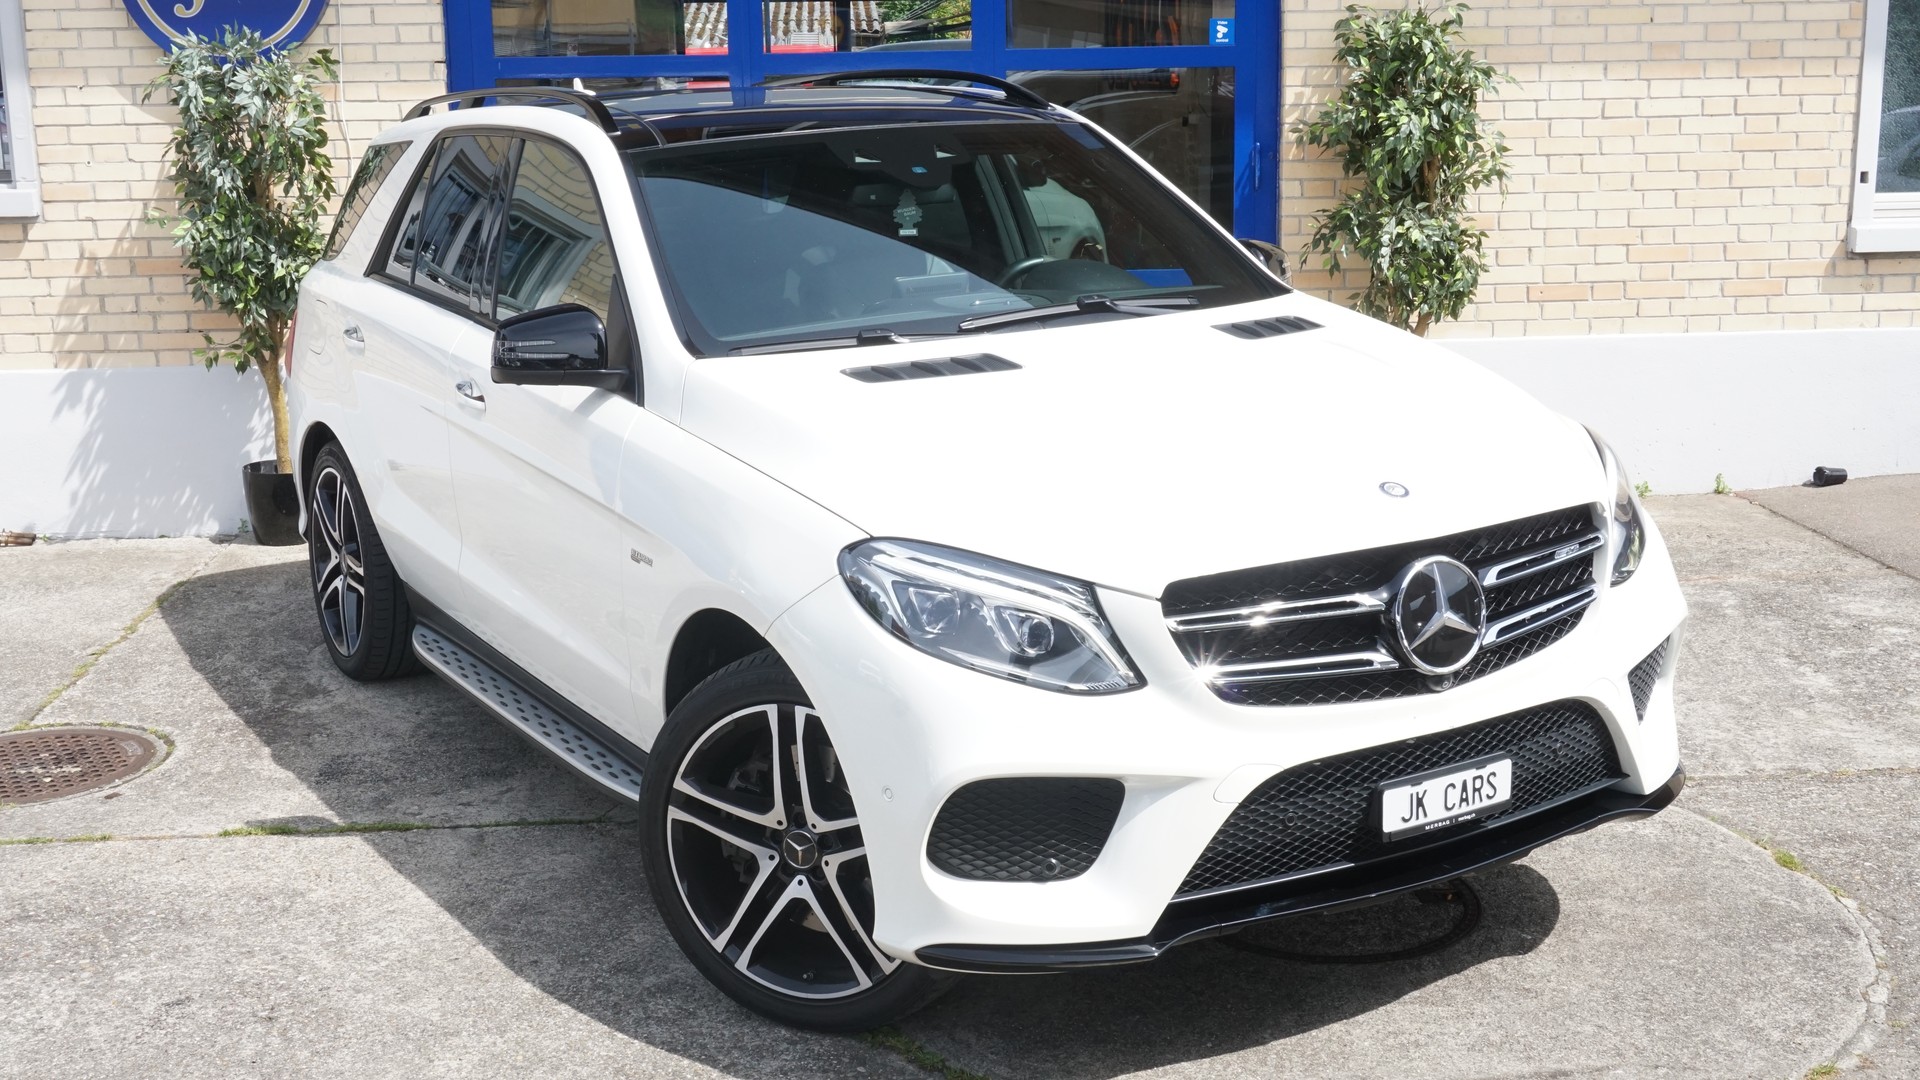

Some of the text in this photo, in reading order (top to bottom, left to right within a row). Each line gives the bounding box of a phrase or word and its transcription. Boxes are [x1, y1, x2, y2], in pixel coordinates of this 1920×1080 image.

[1401, 771, 1497, 823] JK CARS
[1425, 819, 1450, 830] MERBAG
